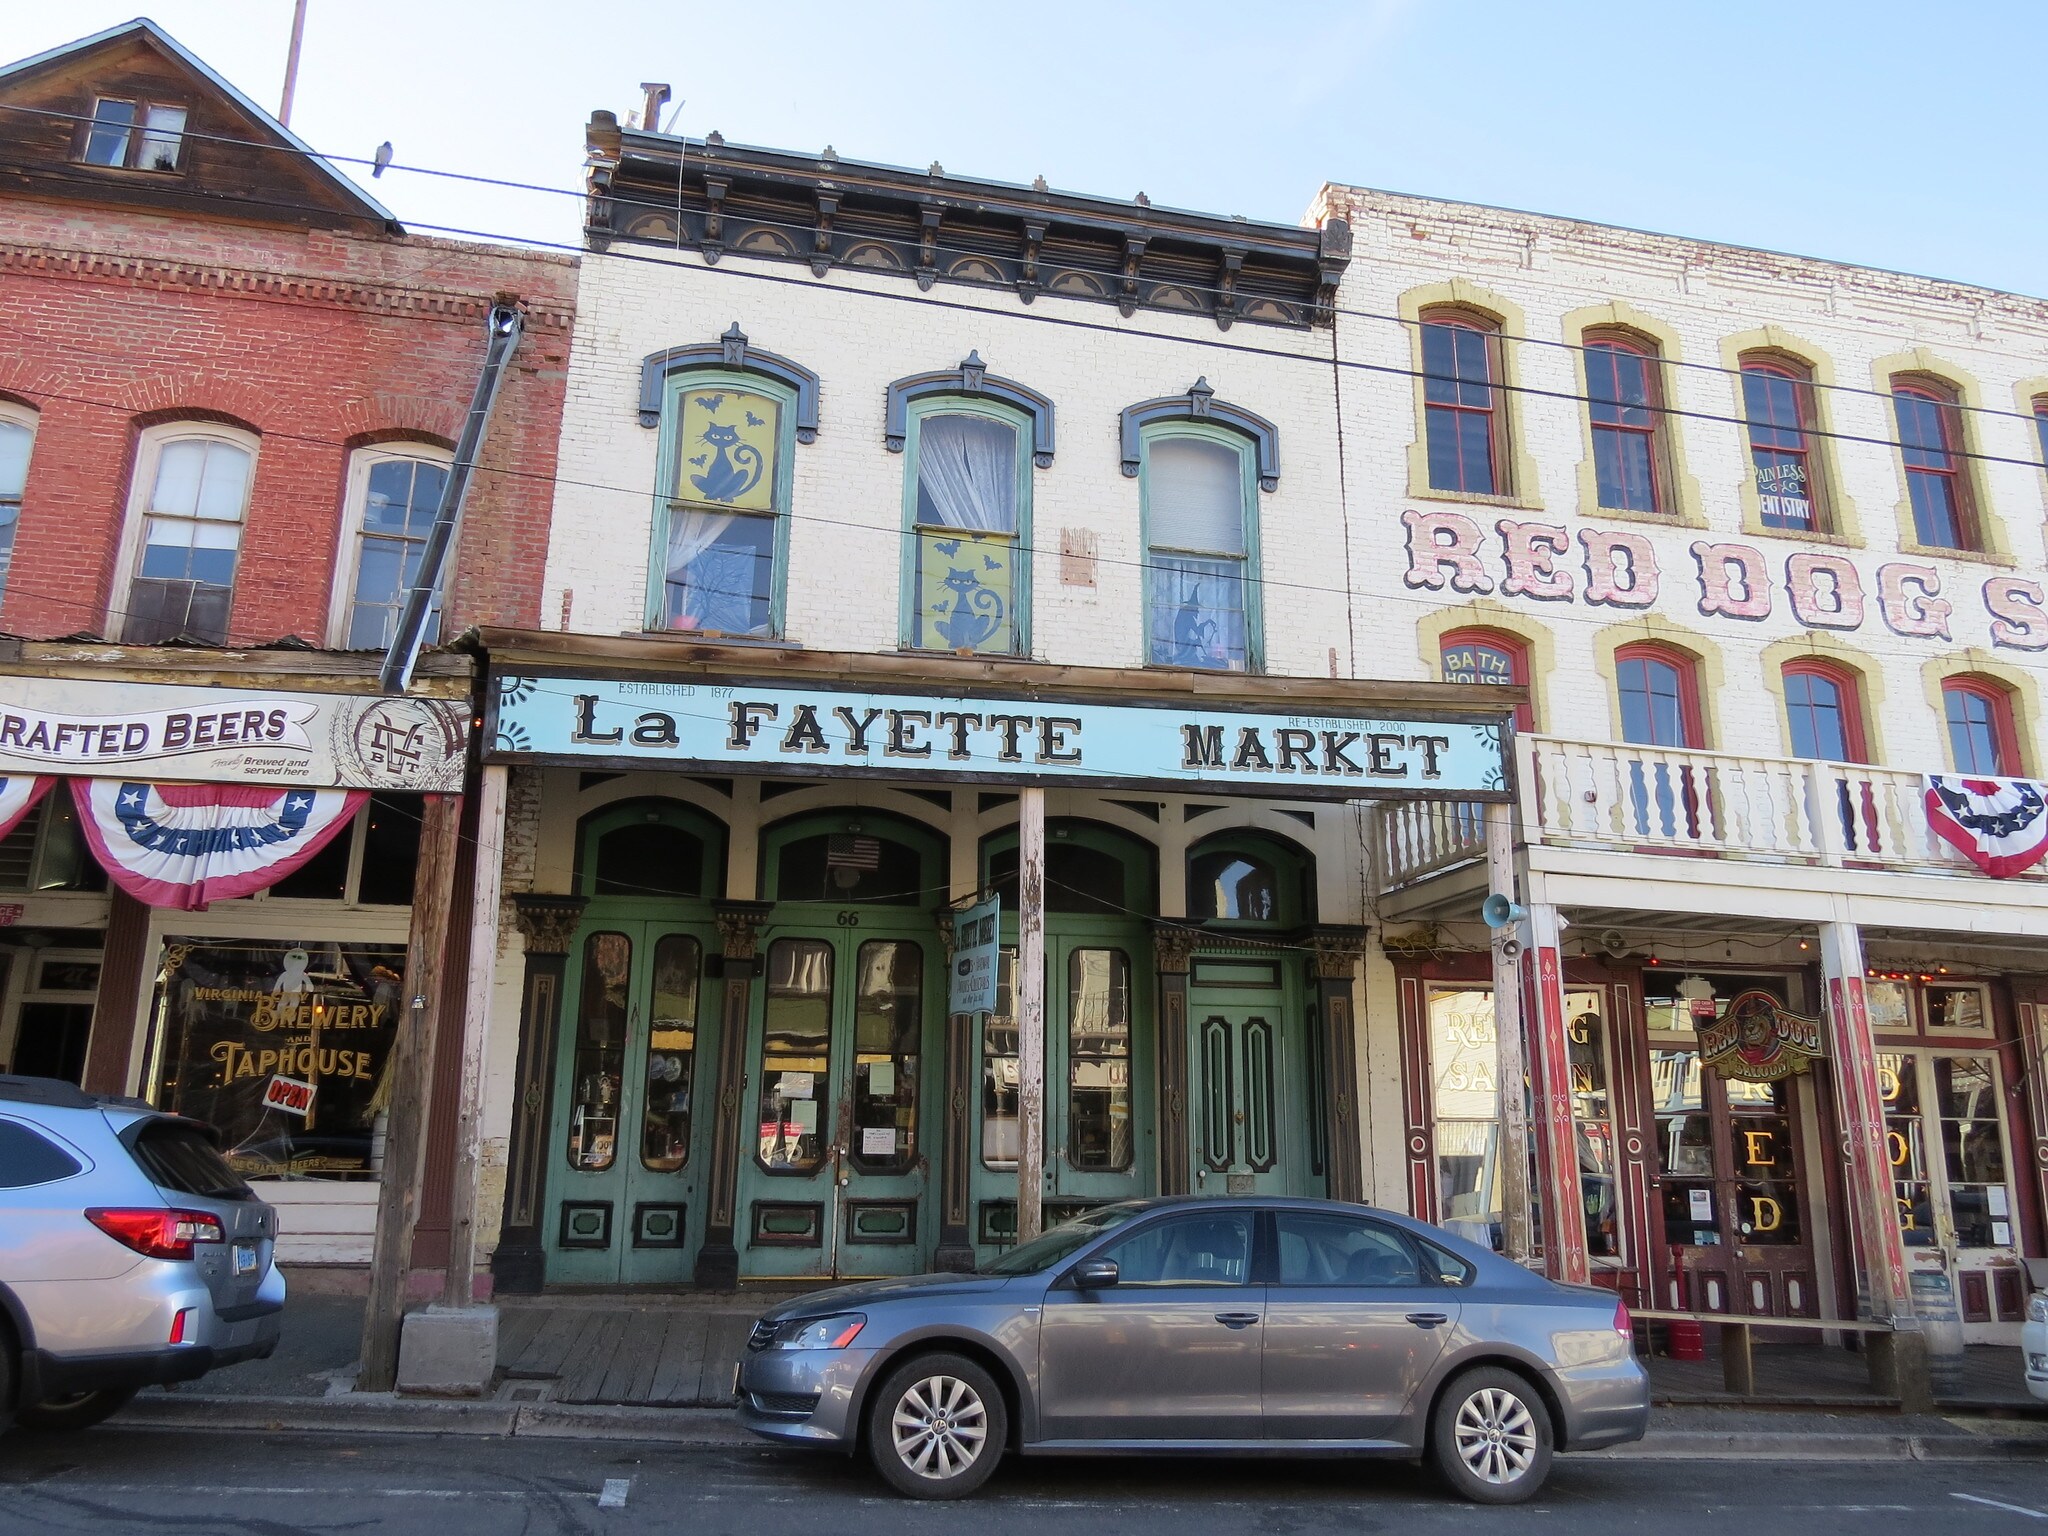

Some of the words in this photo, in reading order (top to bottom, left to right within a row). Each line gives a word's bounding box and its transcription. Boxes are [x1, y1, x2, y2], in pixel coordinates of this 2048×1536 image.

[1760, 494, 1810, 519] ENTISTRY
[1401, 509, 1662, 609] RED
[1446, 652, 1505, 674] BATH
[1445, 672, 1508, 685] HOUSE
[619, 683, 695, 697] ESTABLISHED
[711, 687, 734, 698] 1877
[0, 711, 150, 757] RAFTED
[162, 709, 288, 749] BEERS
[1289, 717, 1371, 730] RE-ESTABLISHED
[1380, 722, 1406, 732] 2000
[571, 694, 680, 748] La
[727, 701, 1083, 766] FAYETTE
[1181, 724, 1449, 781] MARKET
[244, 757, 286, 766] Brewed
[287, 759, 309, 767] and
[244, 767, 284, 775] served
[283, 767, 309, 776] here
[837, 911, 859, 926] 66
[194, 987, 264, 1002] VIRGINIA
[250, 995, 387, 1032] BREWERY
[1443, 1011, 1497, 1049] RE
[1702, 1019, 1739, 1058] RED
[1775, 1012, 1820, 1050] DOG
[210, 1041, 373, 1086] TAPHOUSE
[1734, 1060, 1788, 1078] SALOON
[268, 1080, 313, 1111] OPEN
